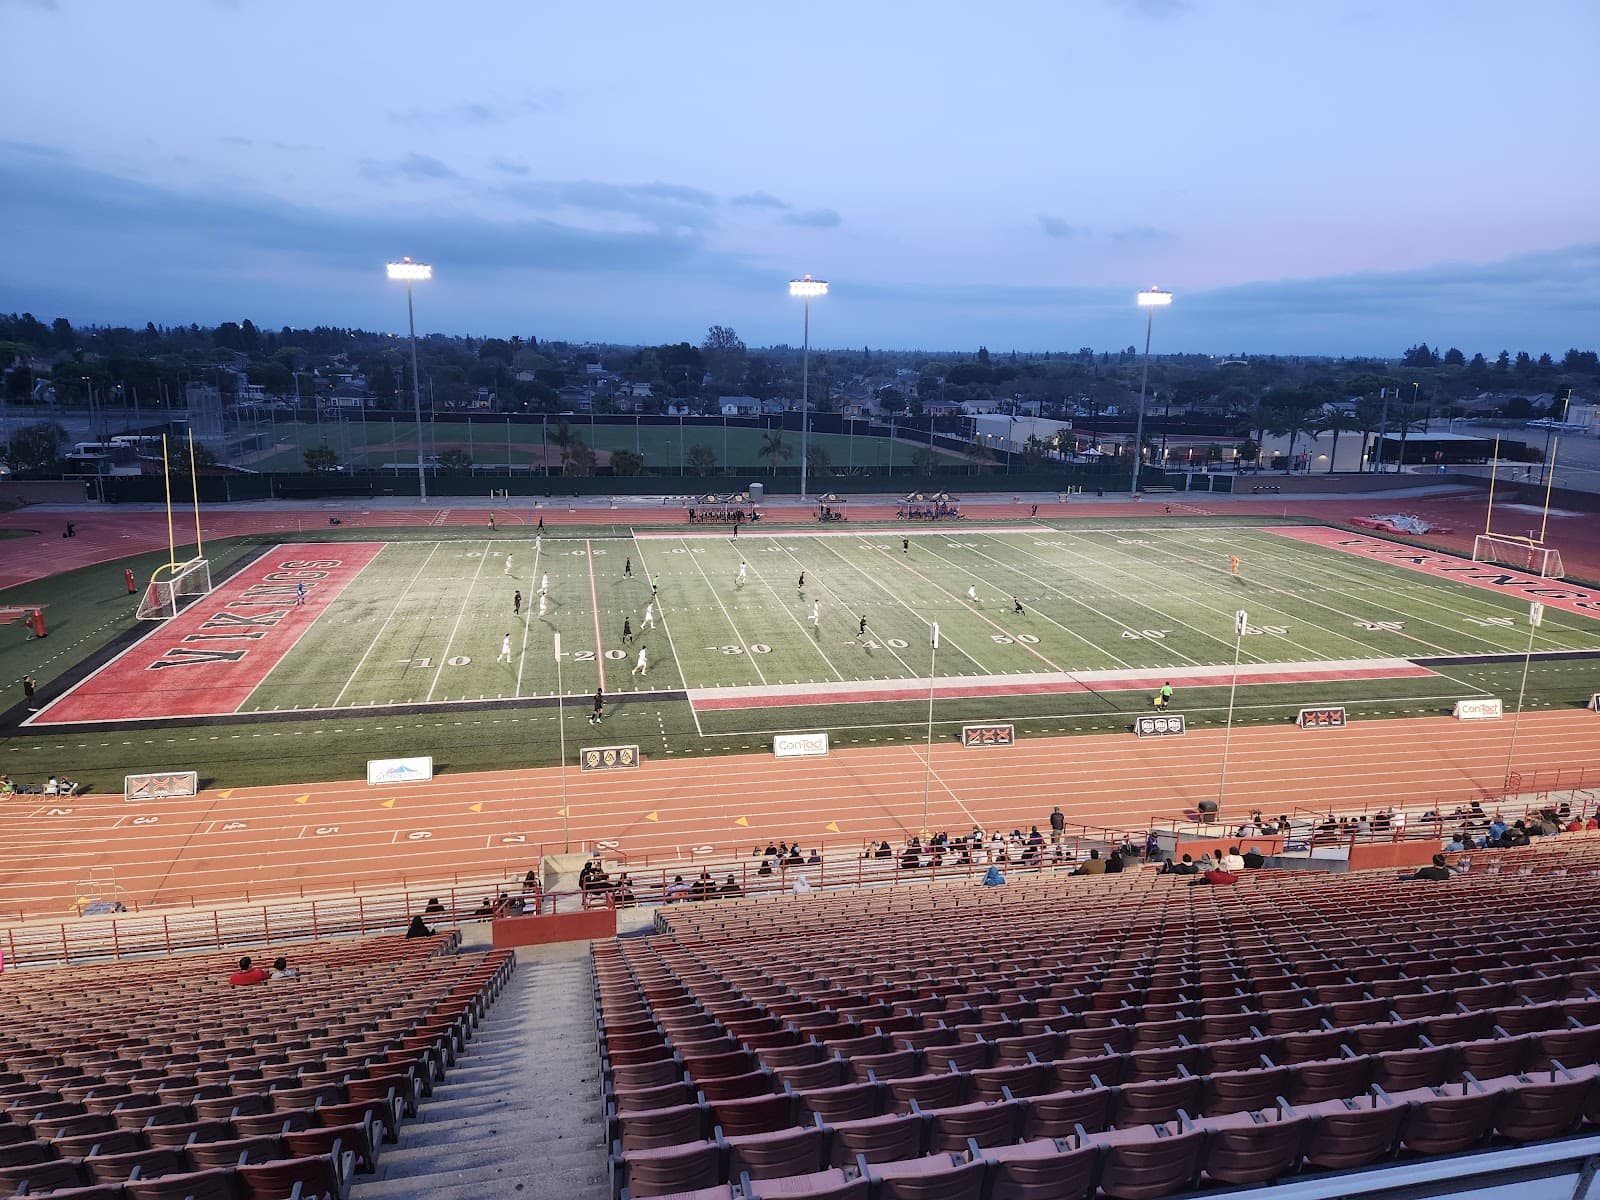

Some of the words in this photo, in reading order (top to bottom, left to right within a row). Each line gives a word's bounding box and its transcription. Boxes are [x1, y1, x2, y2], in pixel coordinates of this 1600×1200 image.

[143, 559, 343, 670] VIKINGS
[862, 638, 910, 649] 40
[991, 634, 1040, 644] 50
[722, 644, 773, 655] 30
[574, 650, 627, 662] 20
[413, 655, 473, 668] 10
[47, 808, 72, 816] 2
[133, 816, 159, 825] 3
[316, 827, 340, 835] 5
[409, 831, 433, 840] 6
[502, 835, 526, 844] 7
